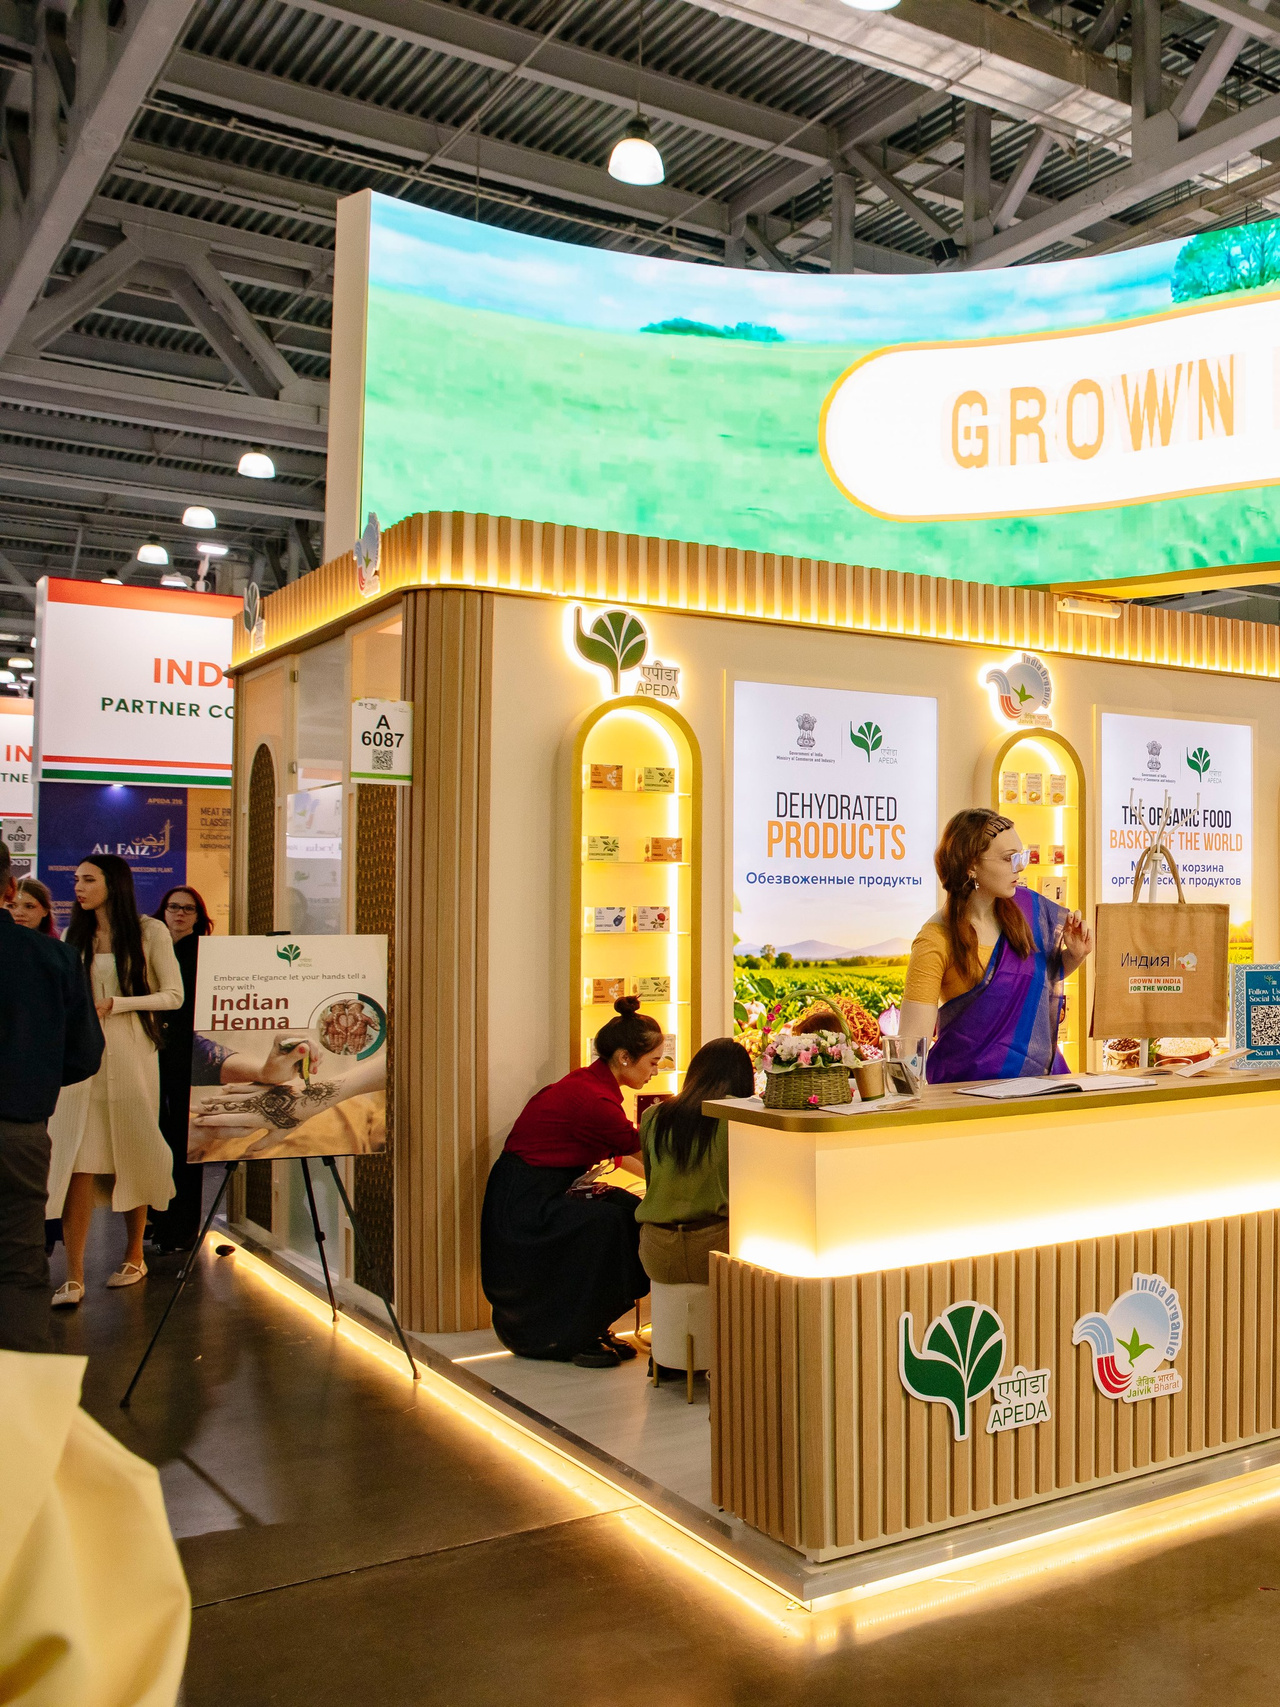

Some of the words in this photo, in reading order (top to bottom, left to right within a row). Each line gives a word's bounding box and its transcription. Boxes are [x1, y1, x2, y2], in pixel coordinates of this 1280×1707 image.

[951, 352, 1237, 469] GROWN
[636, 682, 678, 698] APEDA
[101, 697, 200, 717] PARTNER
[376, 714, 390, 730] A
[362, 731, 404, 748] 6087
[878, 757, 898, 765] APEDA
[200, 808, 220, 816] MEAT
[776, 791, 898, 822] DEHYDRATED
[1203, 809, 1231, 829] FOOD
[767, 820, 906, 861] PRODUCTS
[1110, 829, 1157, 850] BASKET
[1178, 831, 1200, 851] THE
[1203, 832, 1243, 852] WORLD
[117, 843, 150, 856] FAIZ
[1182, 863, 1224, 875] корзина
[746, 871, 855, 886] Обезвоженные
[859, 873, 922, 890] продукты
[1111, 876, 1186, 888] оргаиескх
[1188, 876, 1242, 888] продуктов
[1121, 952, 1170, 969] Индия
[213, 974, 250, 982] Embrace
[252, 974, 287, 983] Elegance
[301, 974, 319, 982] your
[213, 984, 235, 992] story
[1248, 988, 1269, 996] Follow
[212, 993, 289, 1011] Indian
[211, 1013, 290, 1031] Henna
[1255, 1049, 1273, 1057] Scan
[1136, 1275, 1167, 1299] India
[1165, 1292, 1182, 1358] Organic
[998, 1371, 1048, 1404] एपीडा
[1126, 1385, 1152, 1399] Jaivik
[1153, 1379, 1180, 1392] Bharat
[991, 1402, 1048, 1429] APEDA
